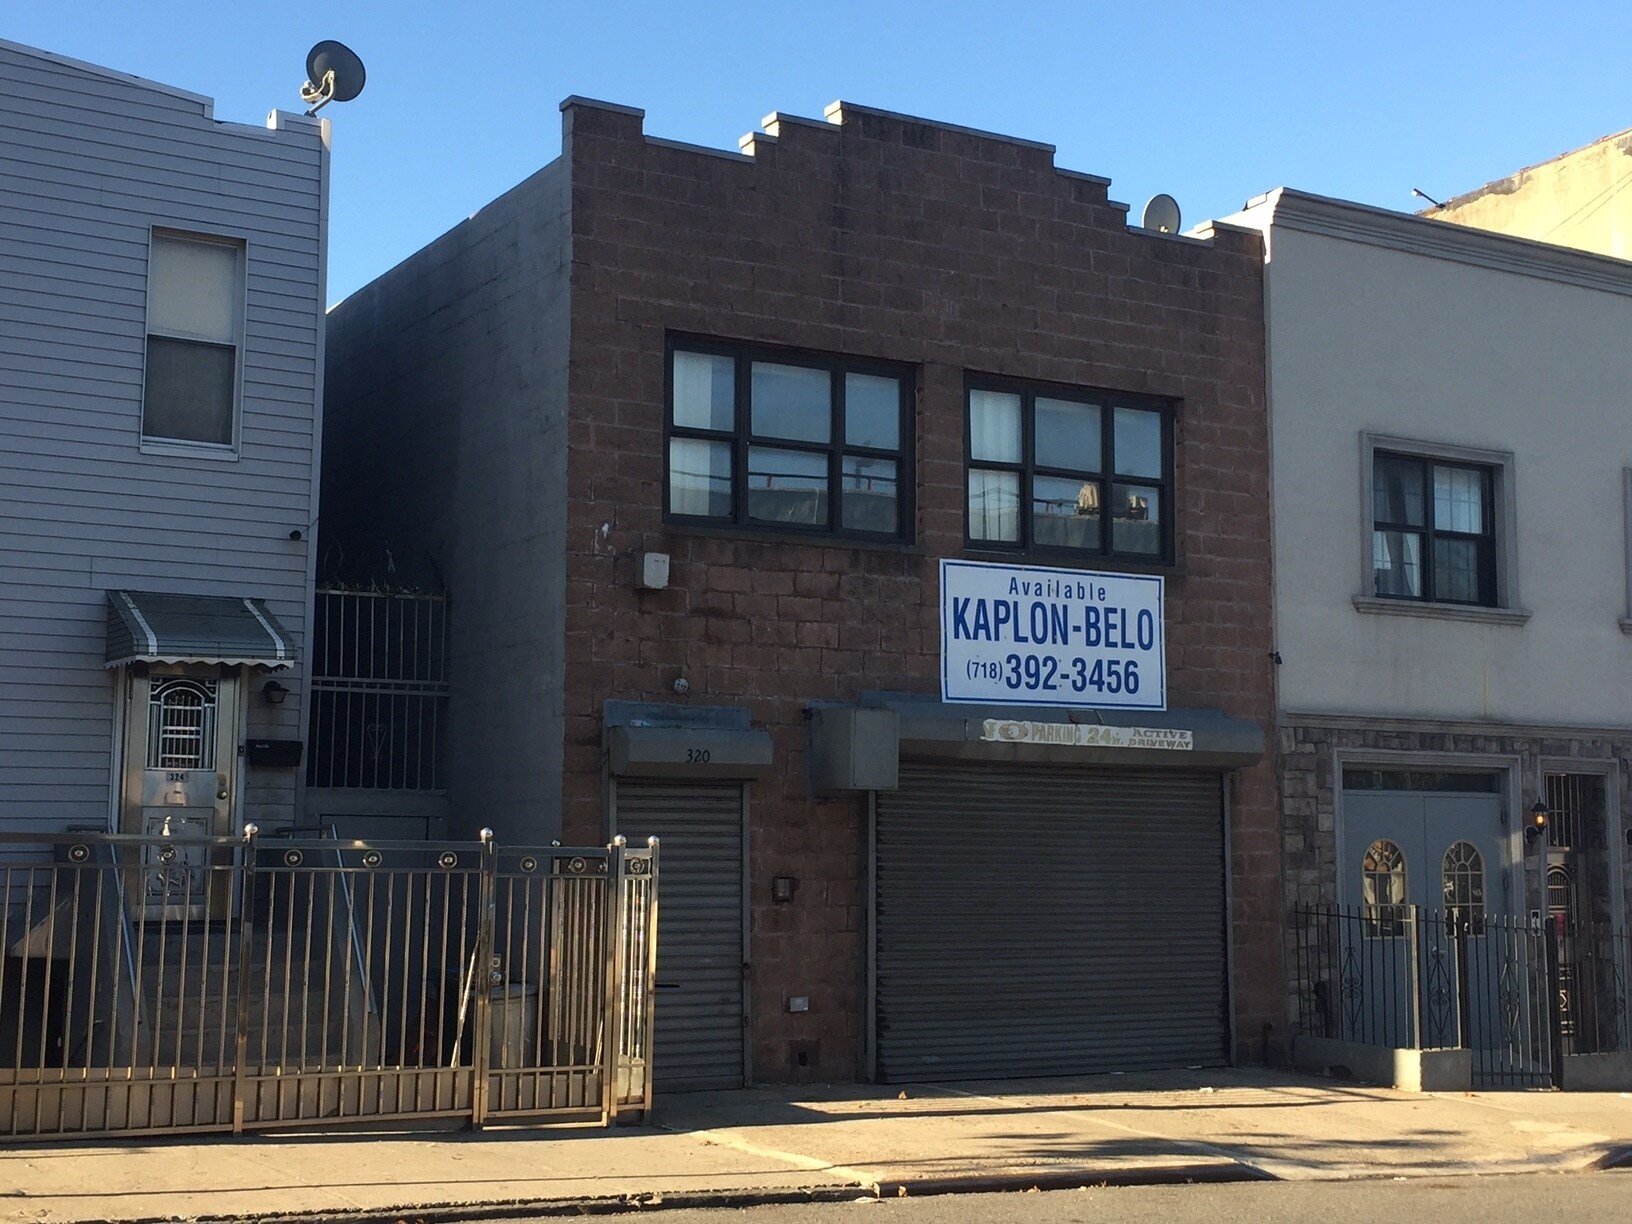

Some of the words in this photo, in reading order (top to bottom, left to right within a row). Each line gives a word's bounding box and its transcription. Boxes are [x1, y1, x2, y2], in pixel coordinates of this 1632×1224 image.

[1008, 577, 1106, 601] Available
[953, 597, 1154, 650] KAPLON-BELO
[1006, 654, 1139, 694] 392-3456
[1031, 724, 1080, 743] PARKING
[1132, 728, 1187, 740] ACTIVE
[1128, 737, 1190, 749] DRIVEWAY
[685, 749, 711, 763] 320
[170, 772, 184, 781] 324
